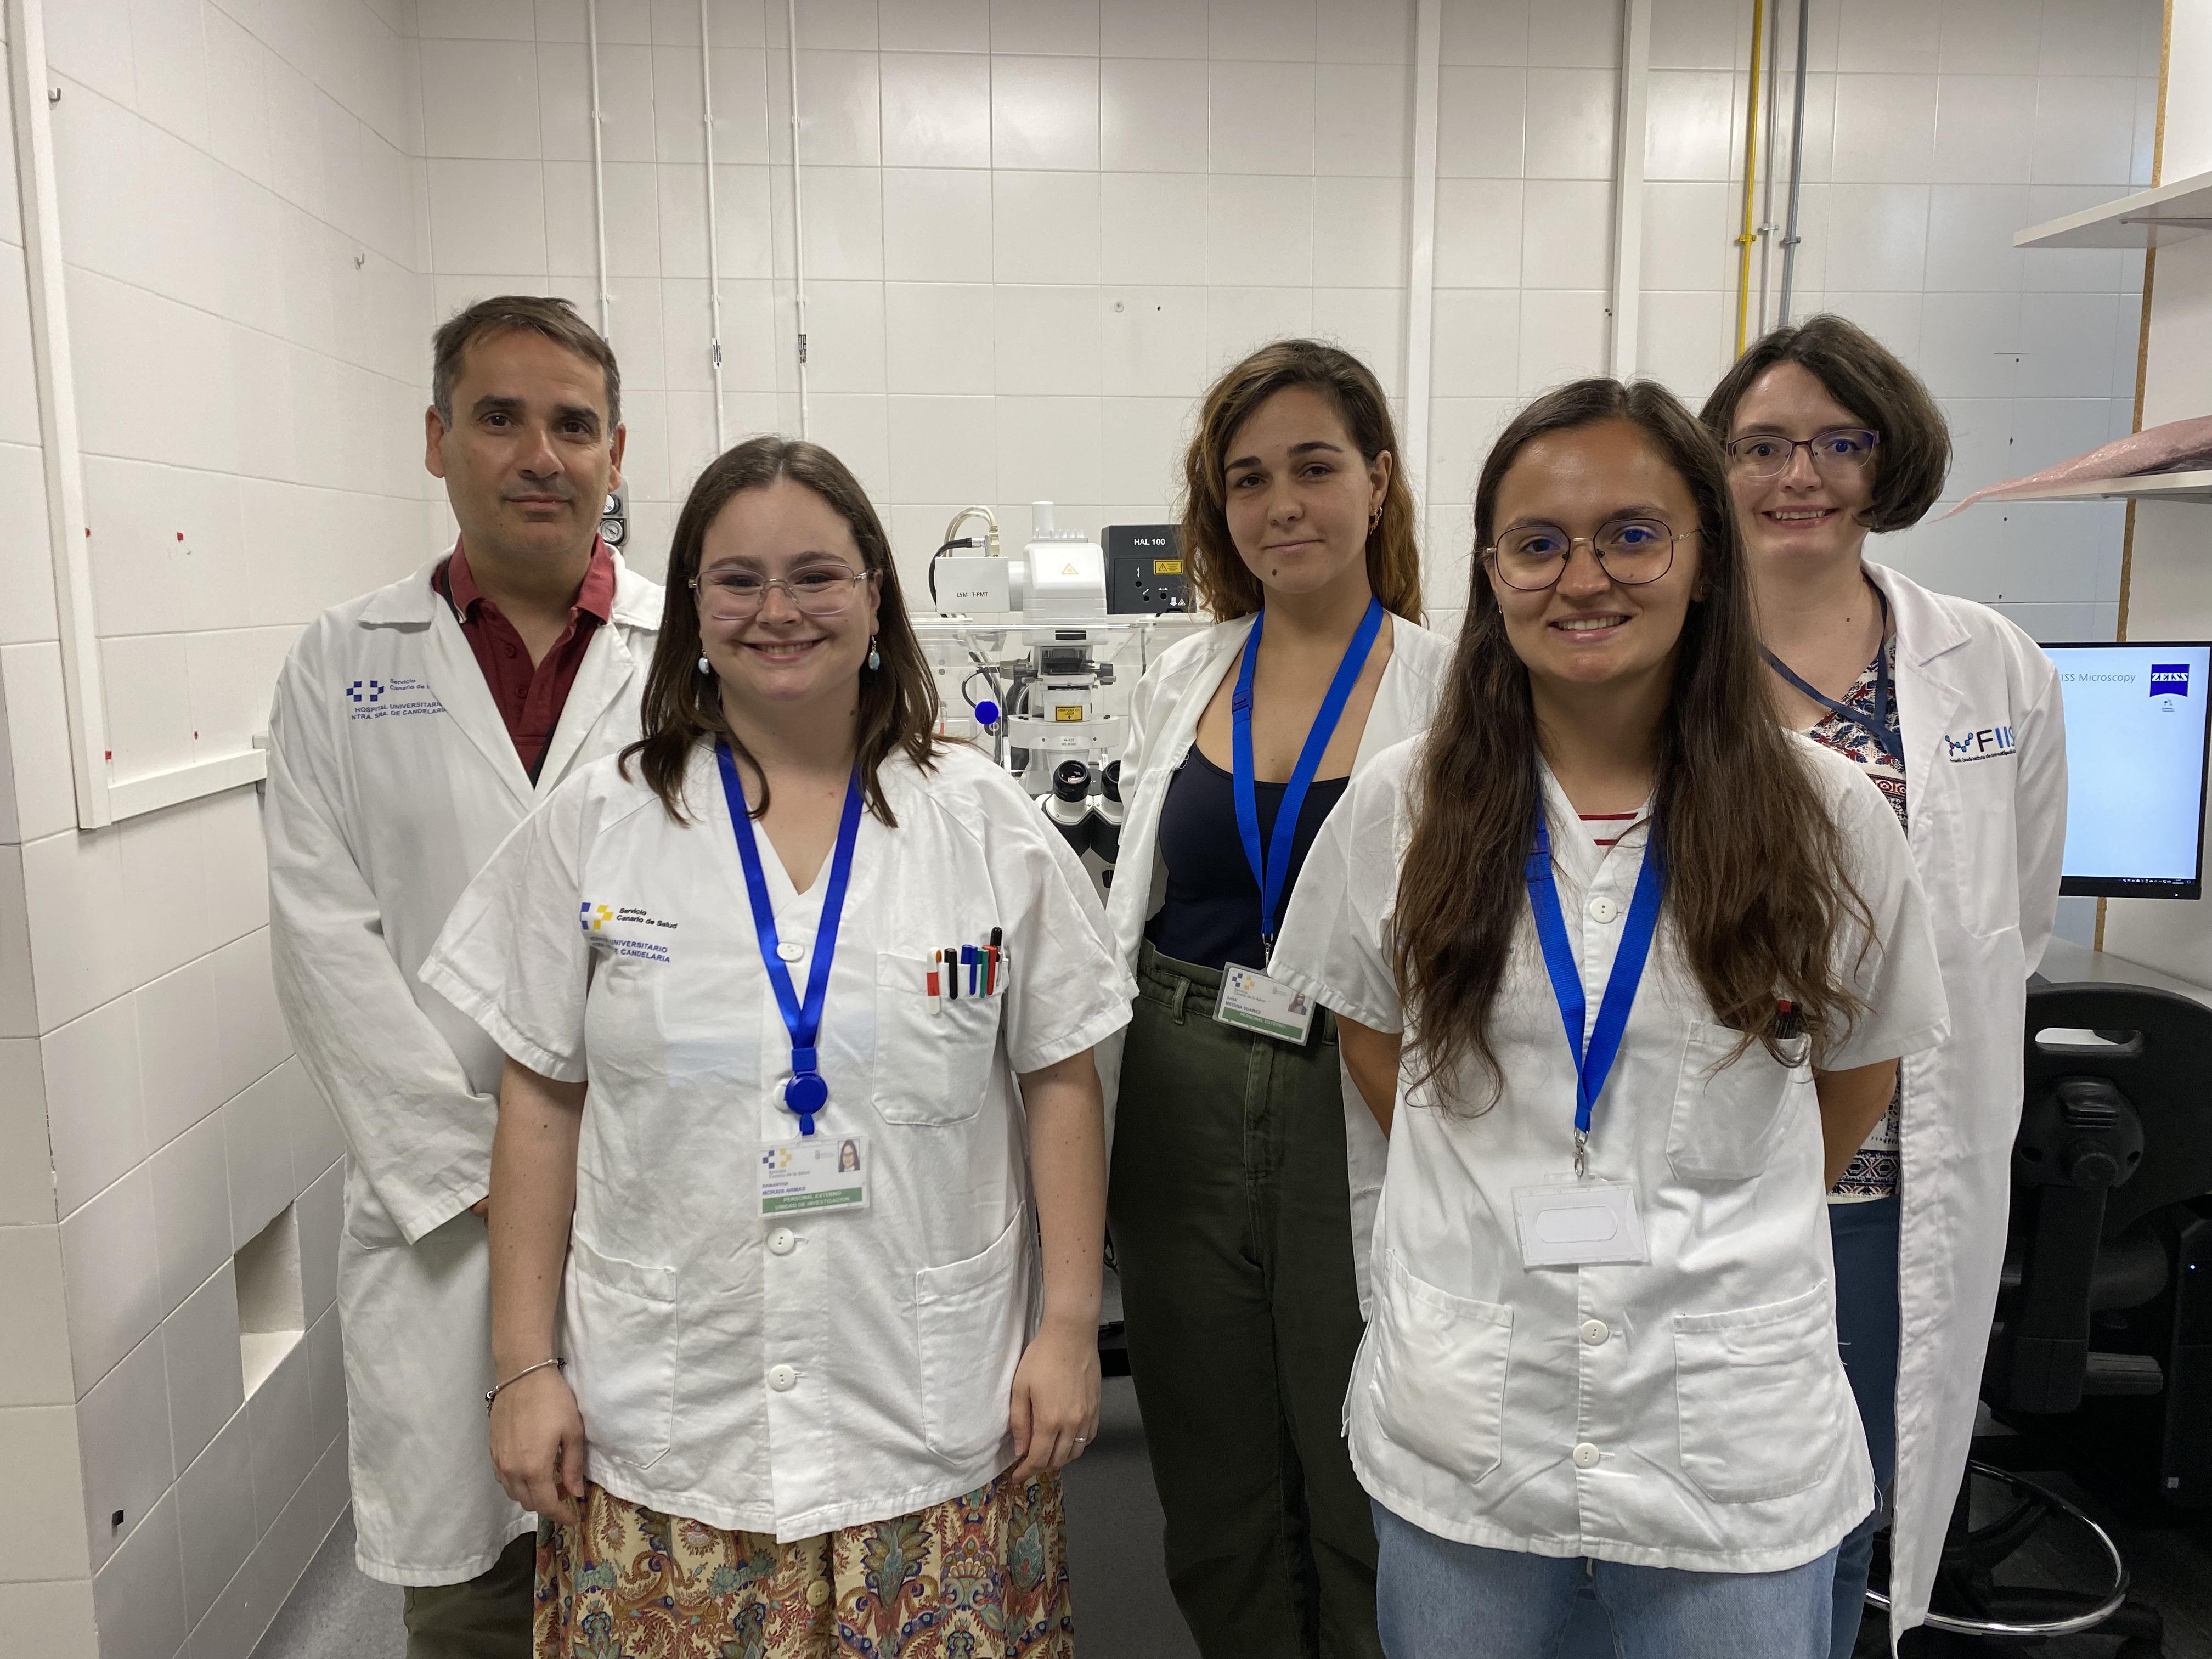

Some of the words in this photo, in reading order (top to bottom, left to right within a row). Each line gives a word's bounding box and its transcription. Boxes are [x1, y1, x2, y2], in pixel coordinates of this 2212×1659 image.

[2059, 673, 2075, 681] ISS
[2079, 673, 2136, 683] Microscopy
[2151, 673, 2188, 682] ZEISS
[657, 920, 679, 929] Salud
[620, 949, 670, 963] CANDELARIA
